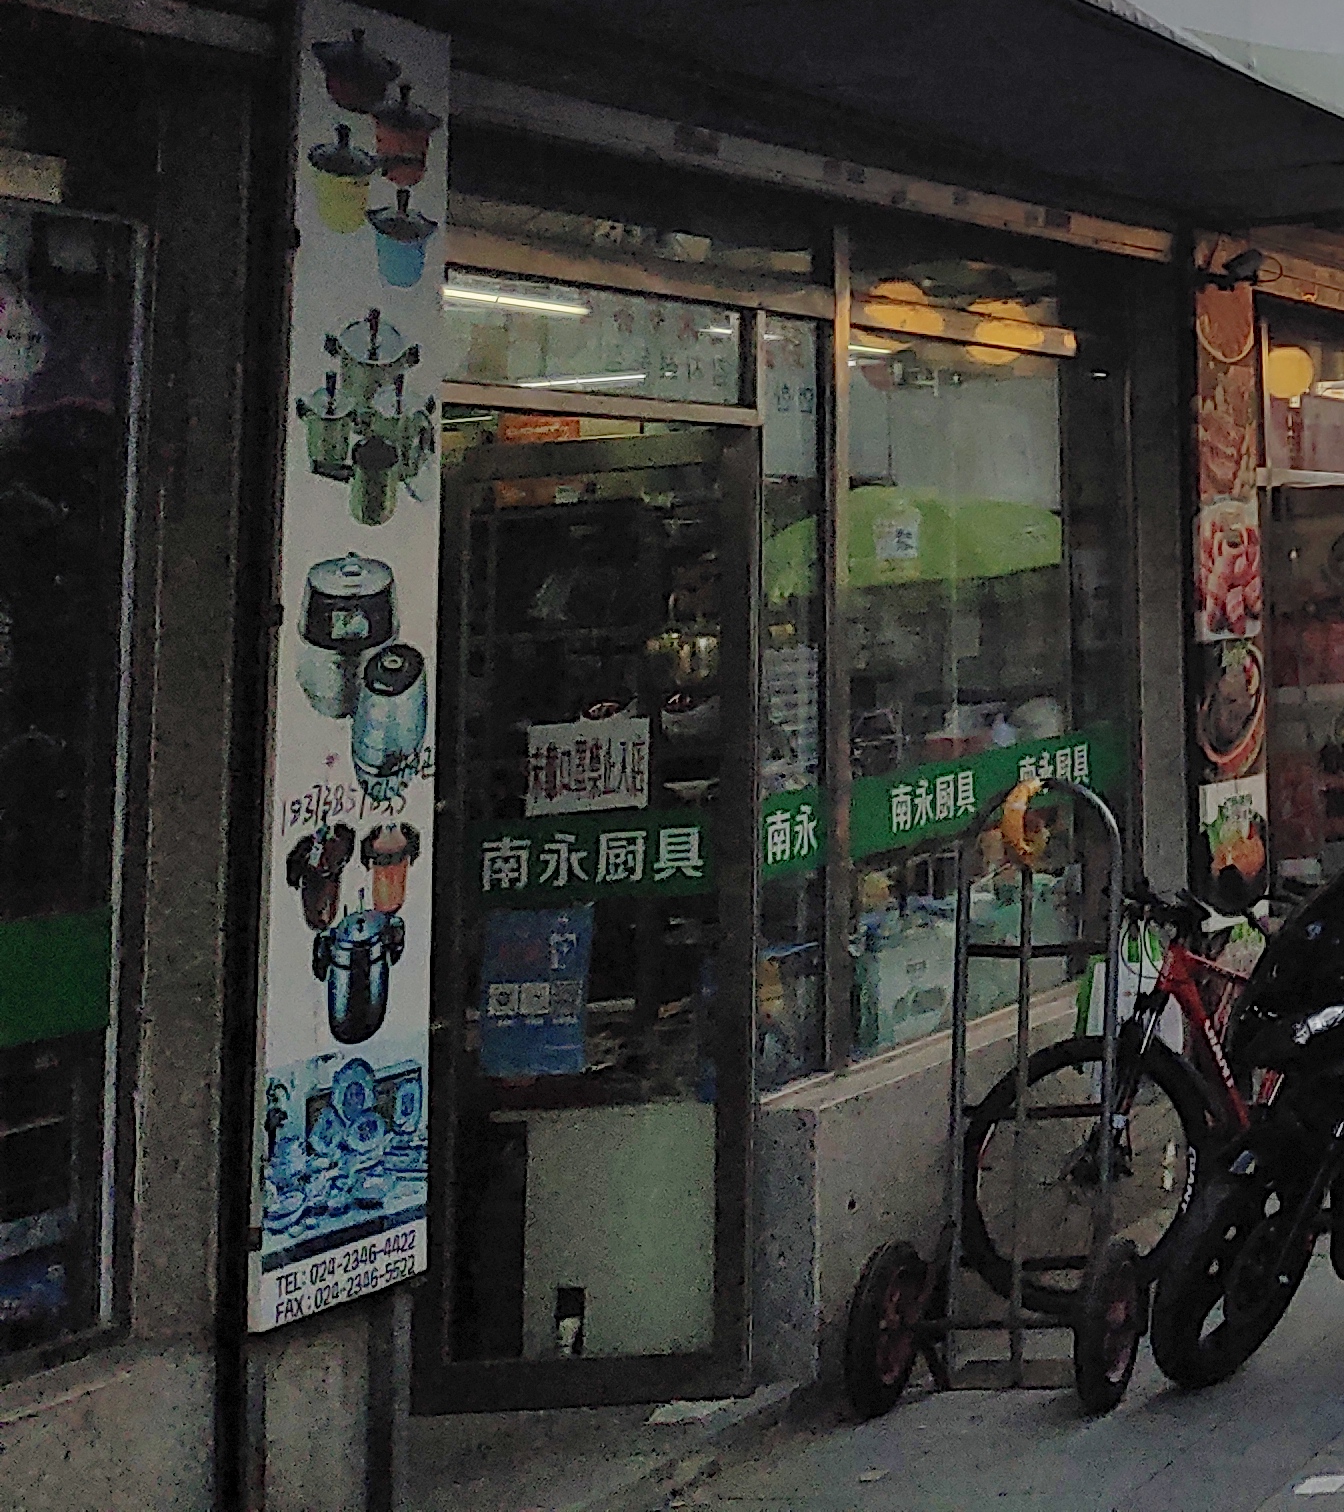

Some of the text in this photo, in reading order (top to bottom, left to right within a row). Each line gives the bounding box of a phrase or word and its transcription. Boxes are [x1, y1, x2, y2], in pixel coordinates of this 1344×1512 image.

[481, 827, 704, 892] 南永厨具
[765, 803, 819, 865] 南永
[890, 767, 976, 833] 南永厨具
